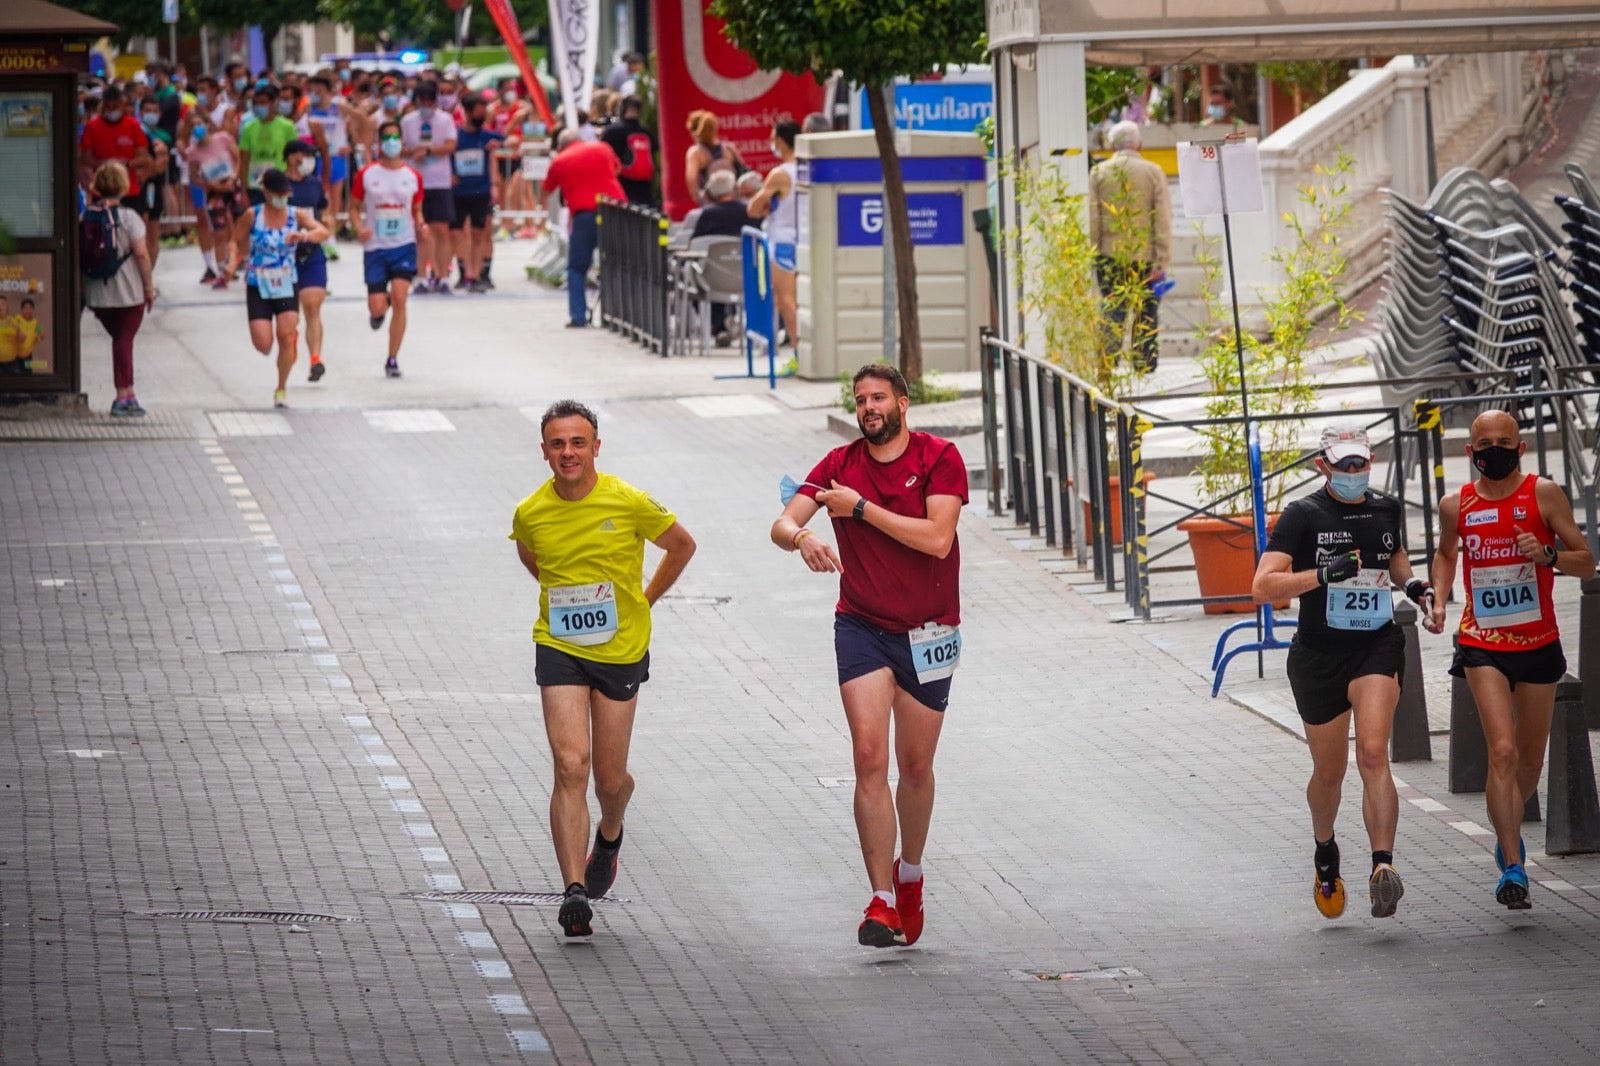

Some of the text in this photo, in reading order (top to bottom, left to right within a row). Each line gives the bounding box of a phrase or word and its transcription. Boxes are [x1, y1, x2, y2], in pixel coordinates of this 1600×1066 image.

[717, 109, 794, 130] utación
[1201, 146, 1215, 159] 38
[1466, 534, 1525, 560] Polisalu
[1345, 592, 1379, 611] 251
[1481, 585, 1534, 609] GUIA
[561, 610, 607, 631] 1009
[923, 639, 958, 665] 1025
